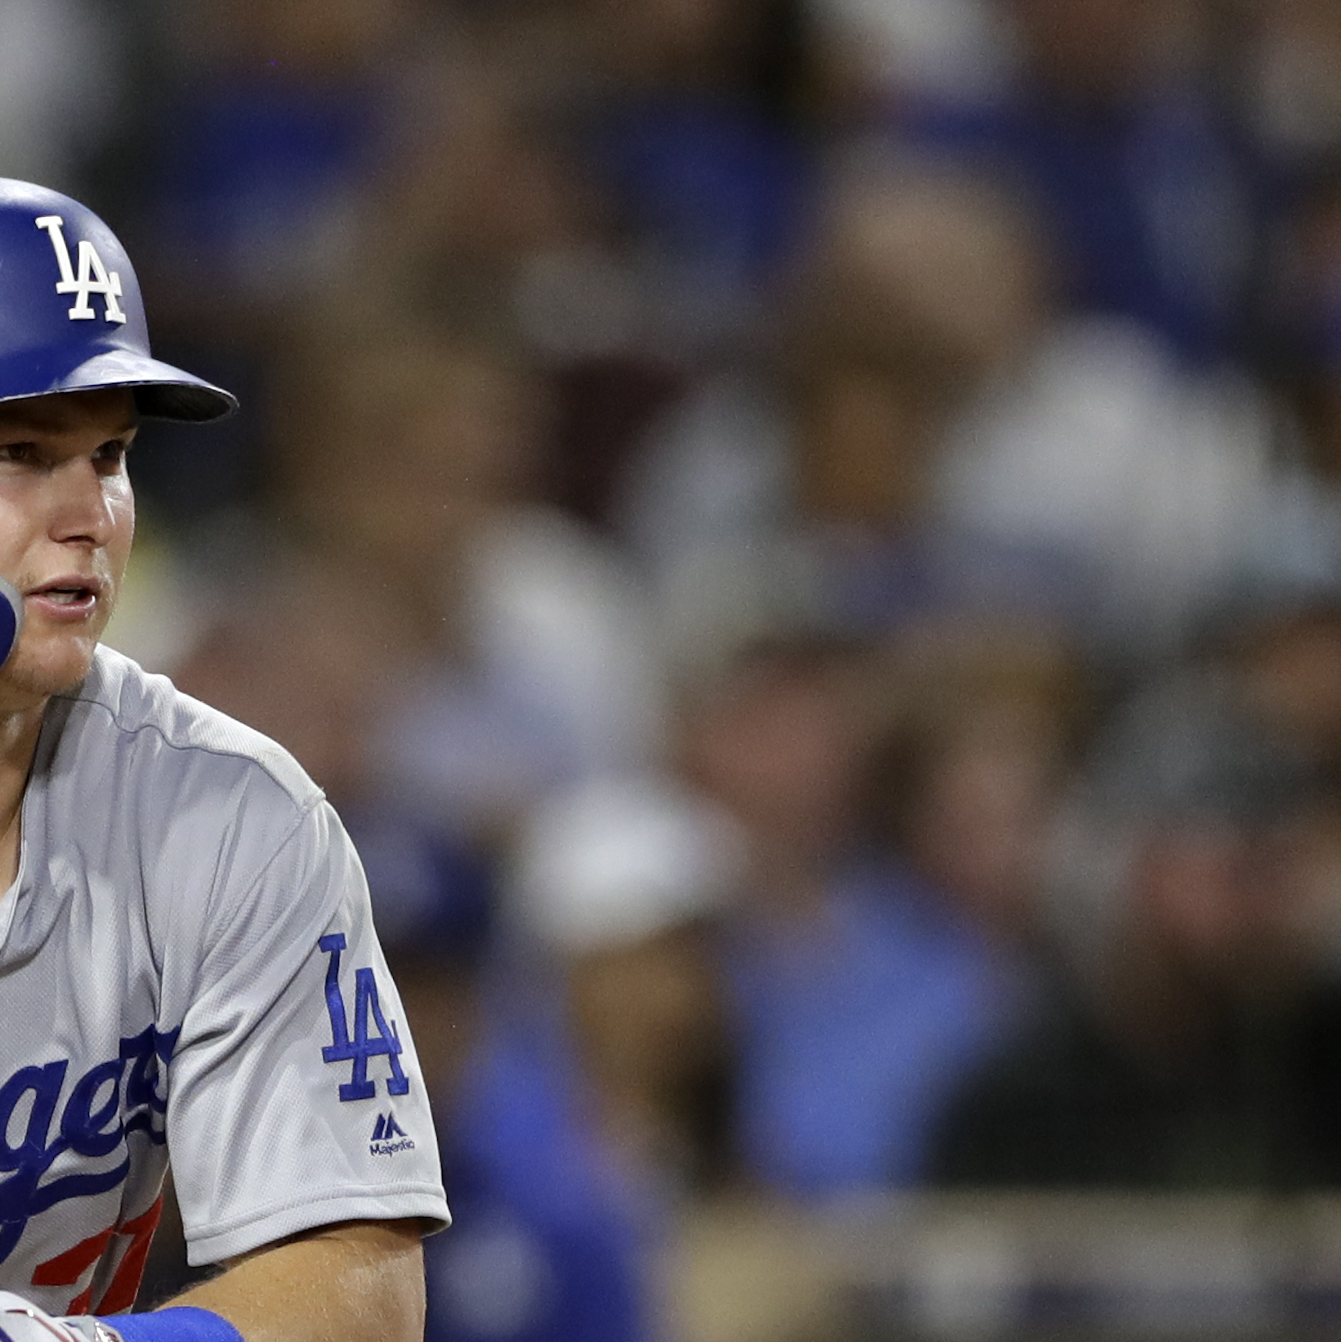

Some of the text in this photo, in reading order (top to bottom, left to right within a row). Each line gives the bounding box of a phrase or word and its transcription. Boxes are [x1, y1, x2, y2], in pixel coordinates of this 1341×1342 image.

[35, 215, 127, 324] LA
[318, 933, 410, 1102] LA
[369, 1138, 415, 1158] Majestic
